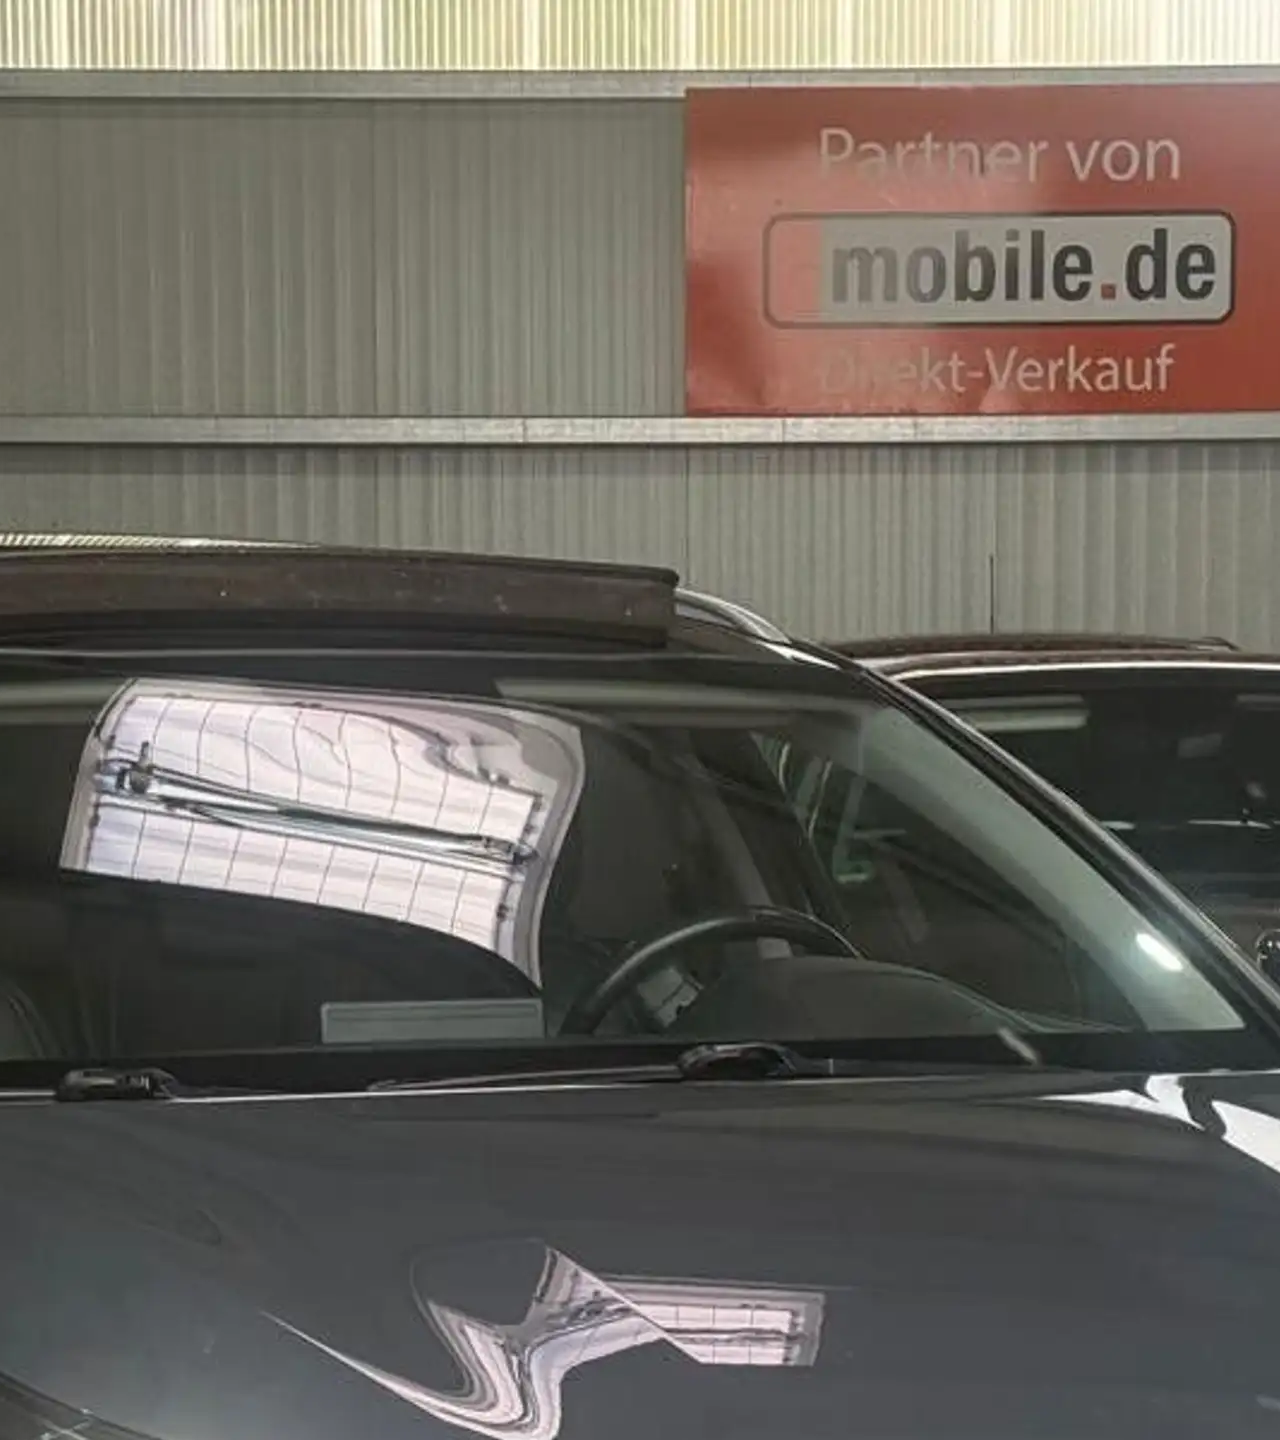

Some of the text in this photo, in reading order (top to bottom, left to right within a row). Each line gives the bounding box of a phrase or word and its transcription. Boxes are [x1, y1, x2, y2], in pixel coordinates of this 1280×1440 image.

[819, 127, 1181, 183] Partner von
[831, 227, 1217, 302] mobile.de
[819, 343, 1176, 394] Dekt-Verkauf
